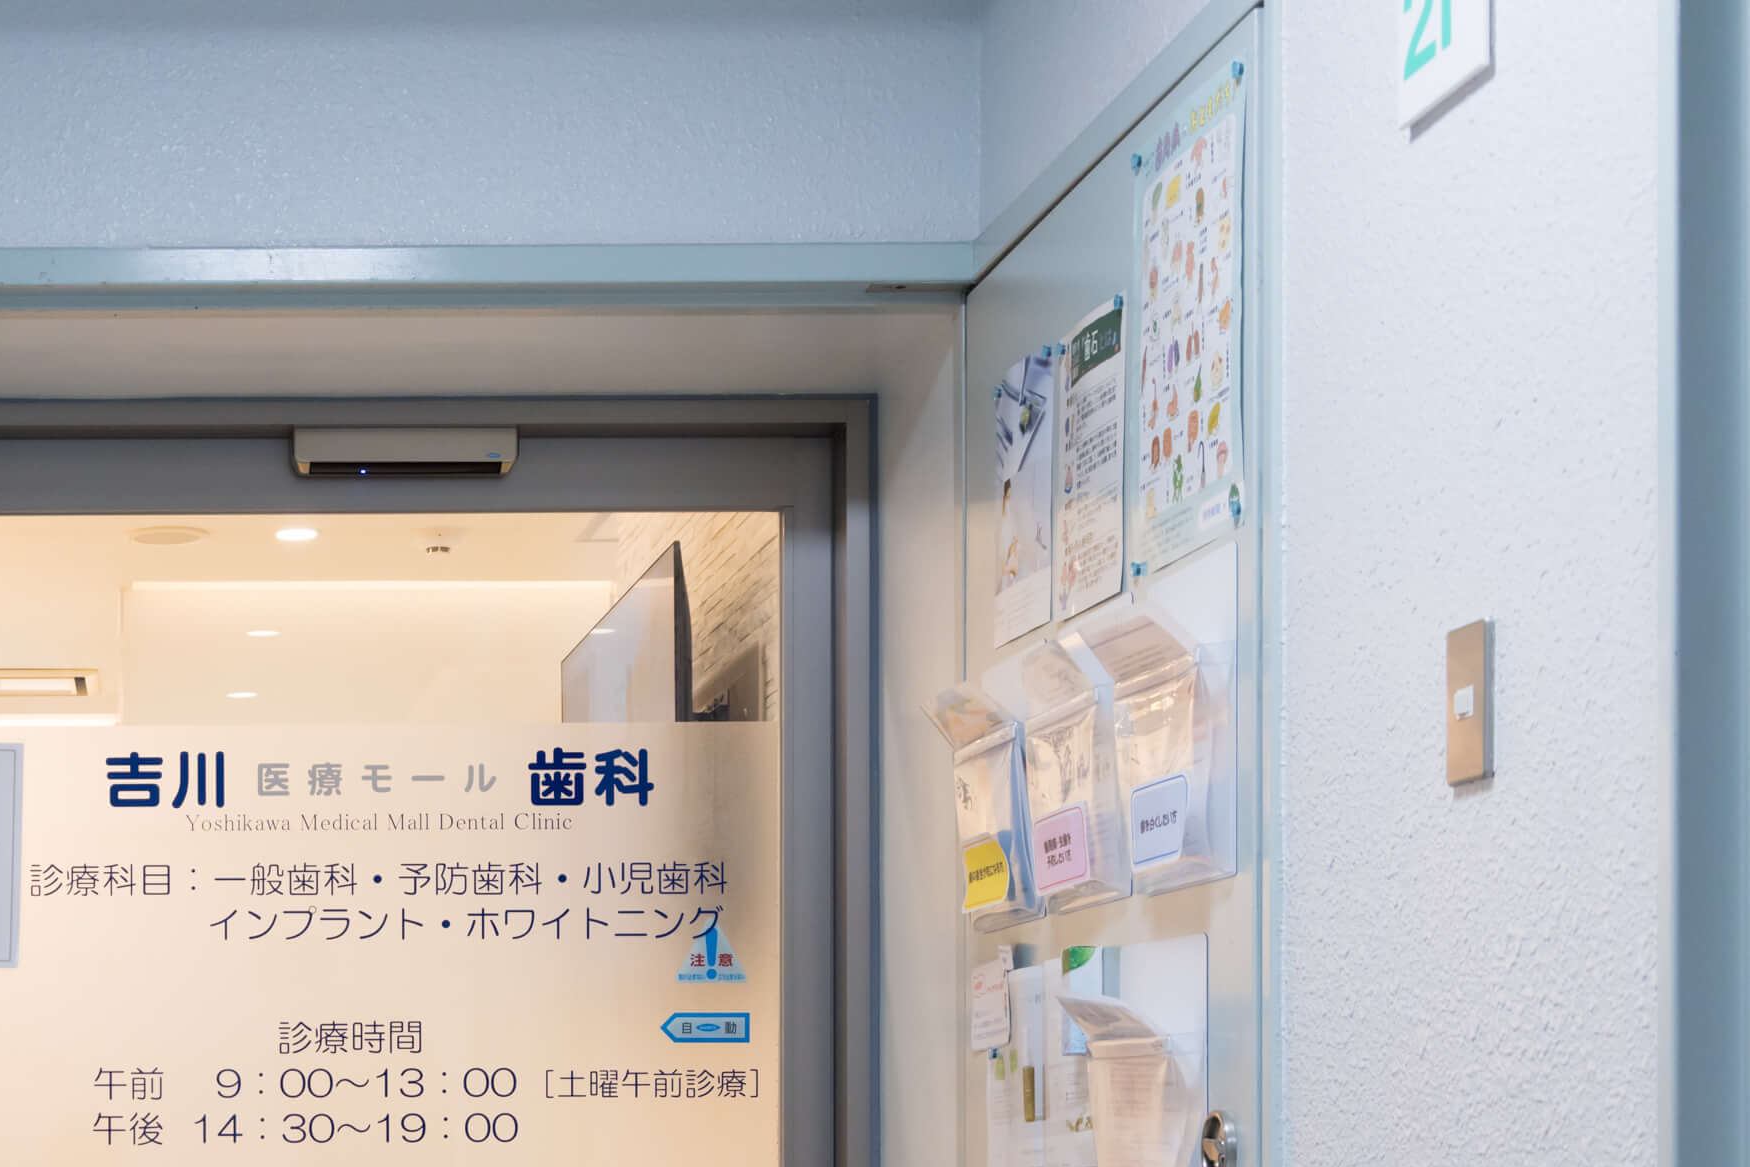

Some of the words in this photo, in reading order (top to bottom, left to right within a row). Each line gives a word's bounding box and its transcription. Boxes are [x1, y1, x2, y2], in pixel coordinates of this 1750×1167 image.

[1403, 0, 1452, 81] 2
[106, 751, 225, 808] 吉川
[256, 762, 496, 797] 医療モール
[528, 747, 654, 807] 歯科
[186, 813, 291, 832] Yoshikawa
[300, 813, 378, 832] Medical
[388, 813, 429, 831] Mall
[439, 813, 504, 831] Dental
[514, 813, 573, 831] Clinic
[210, 905, 724, 940] インプラント・ホワイトニング
[690, 953, 733, 967] 注意
[277, 1020, 423, 1055] 診療時間
[93, 1067, 164, 1100] 午前
[92, 1111, 164, 1146] 午後
